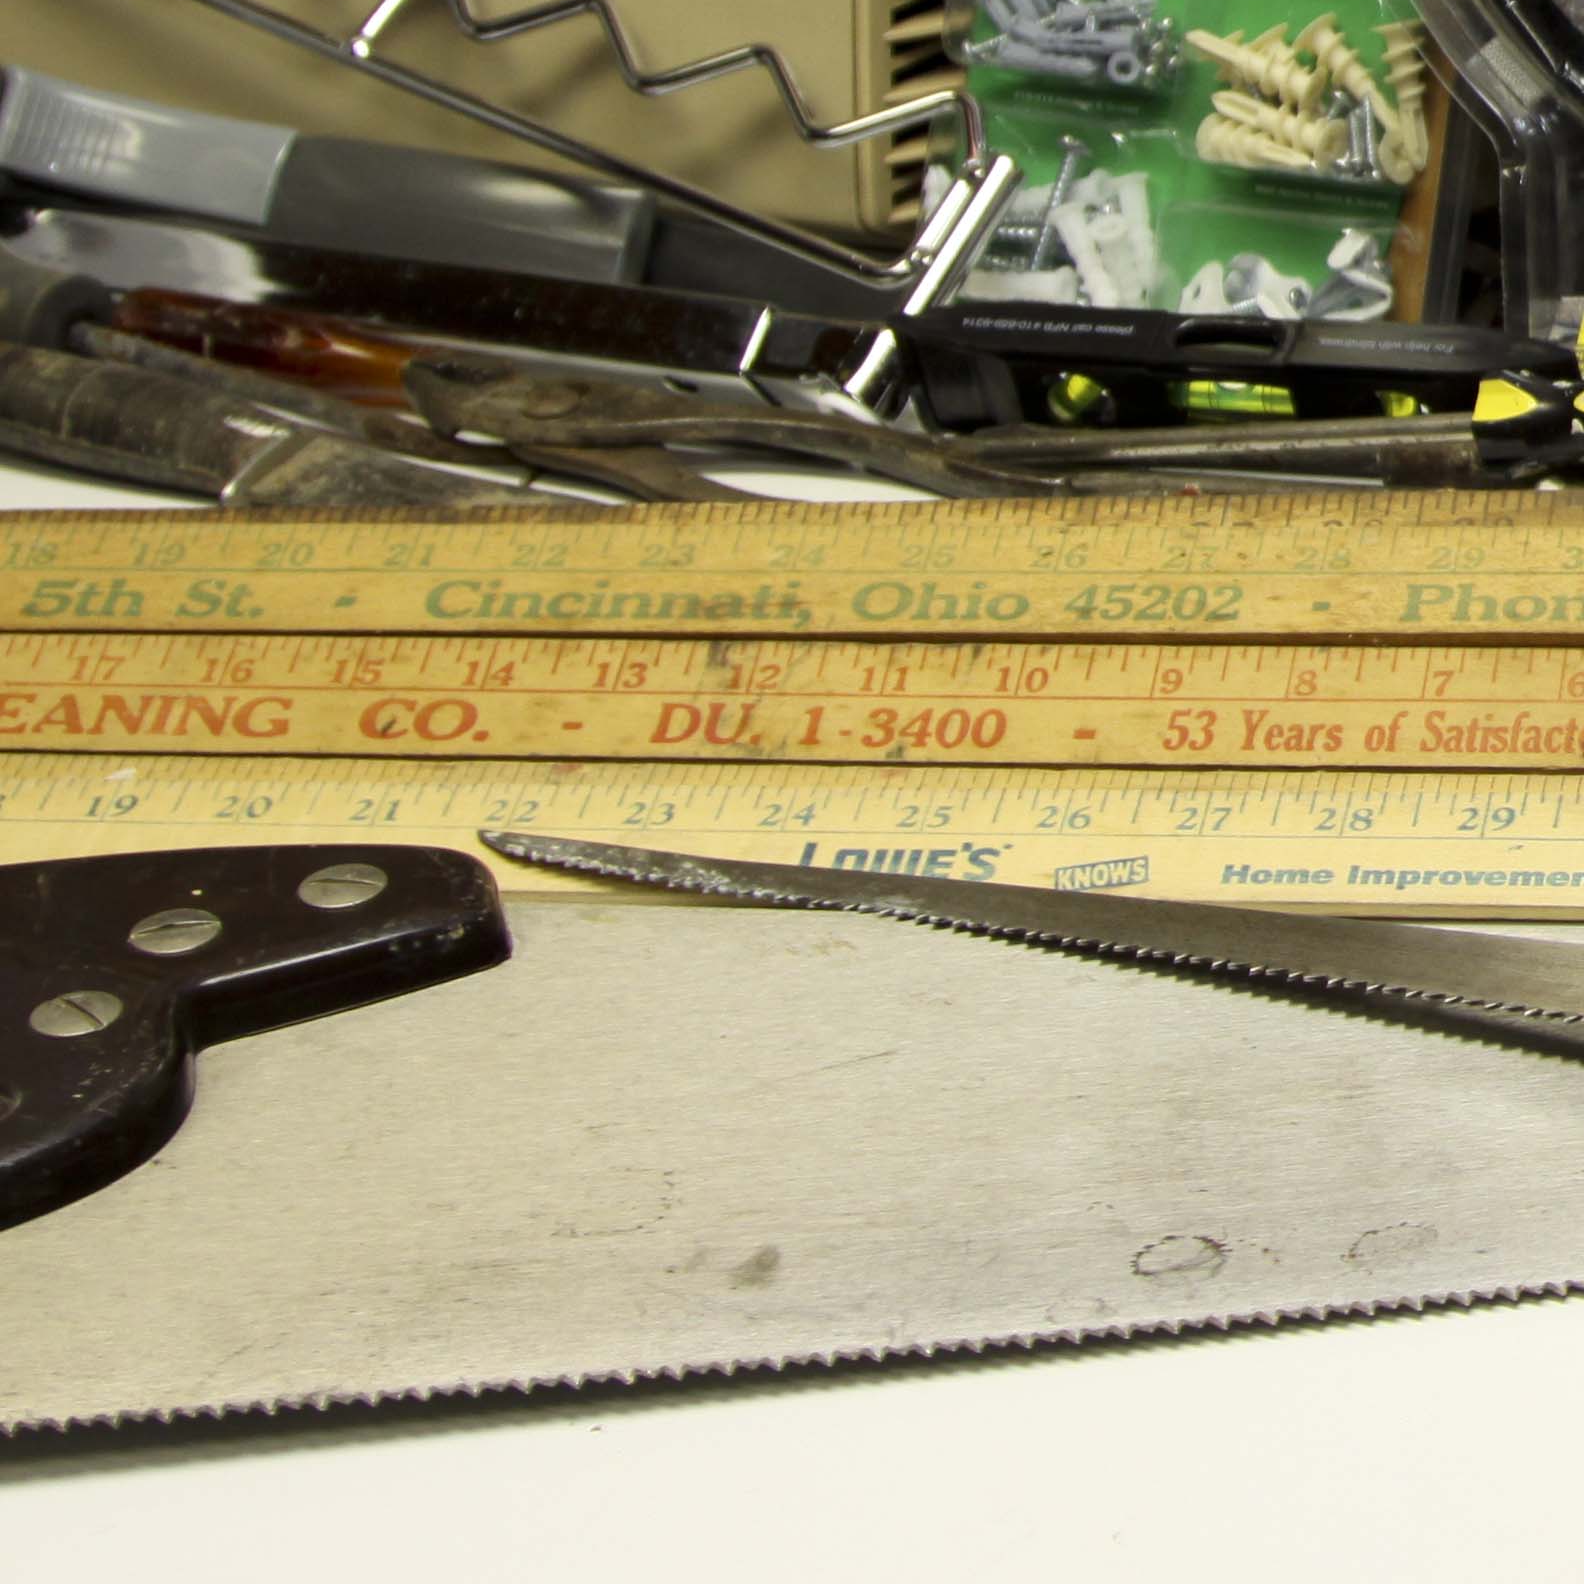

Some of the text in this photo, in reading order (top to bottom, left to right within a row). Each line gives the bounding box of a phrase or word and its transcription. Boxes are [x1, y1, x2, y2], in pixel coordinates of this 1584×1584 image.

[20, 576, 147, 619] 5th
[174, 577, 266, 619] St.
[425, 578, 813, 629] Cincinnati,
[851, 581, 1030, 622] Ohio
[1063, 584, 1245, 623] 45202
[860, 666, 910, 692] 11
[996, 667, 1050, 694] 10
[1160, 668, 1183, 695] 9
[1294, 671, 1318, 697] 8
[1432, 670, 1455, 697] 7
[358, 696, 491, 743] CO.
[651, 702, 763, 747] DU.
[1163, 708, 1218, 751] 53
[1240, 709, 1344, 754] Years
[1364, 709, 1410, 754] of
[1055, 856, 1149, 892] KNOWS
[1220, 864, 1334, 887] Home
